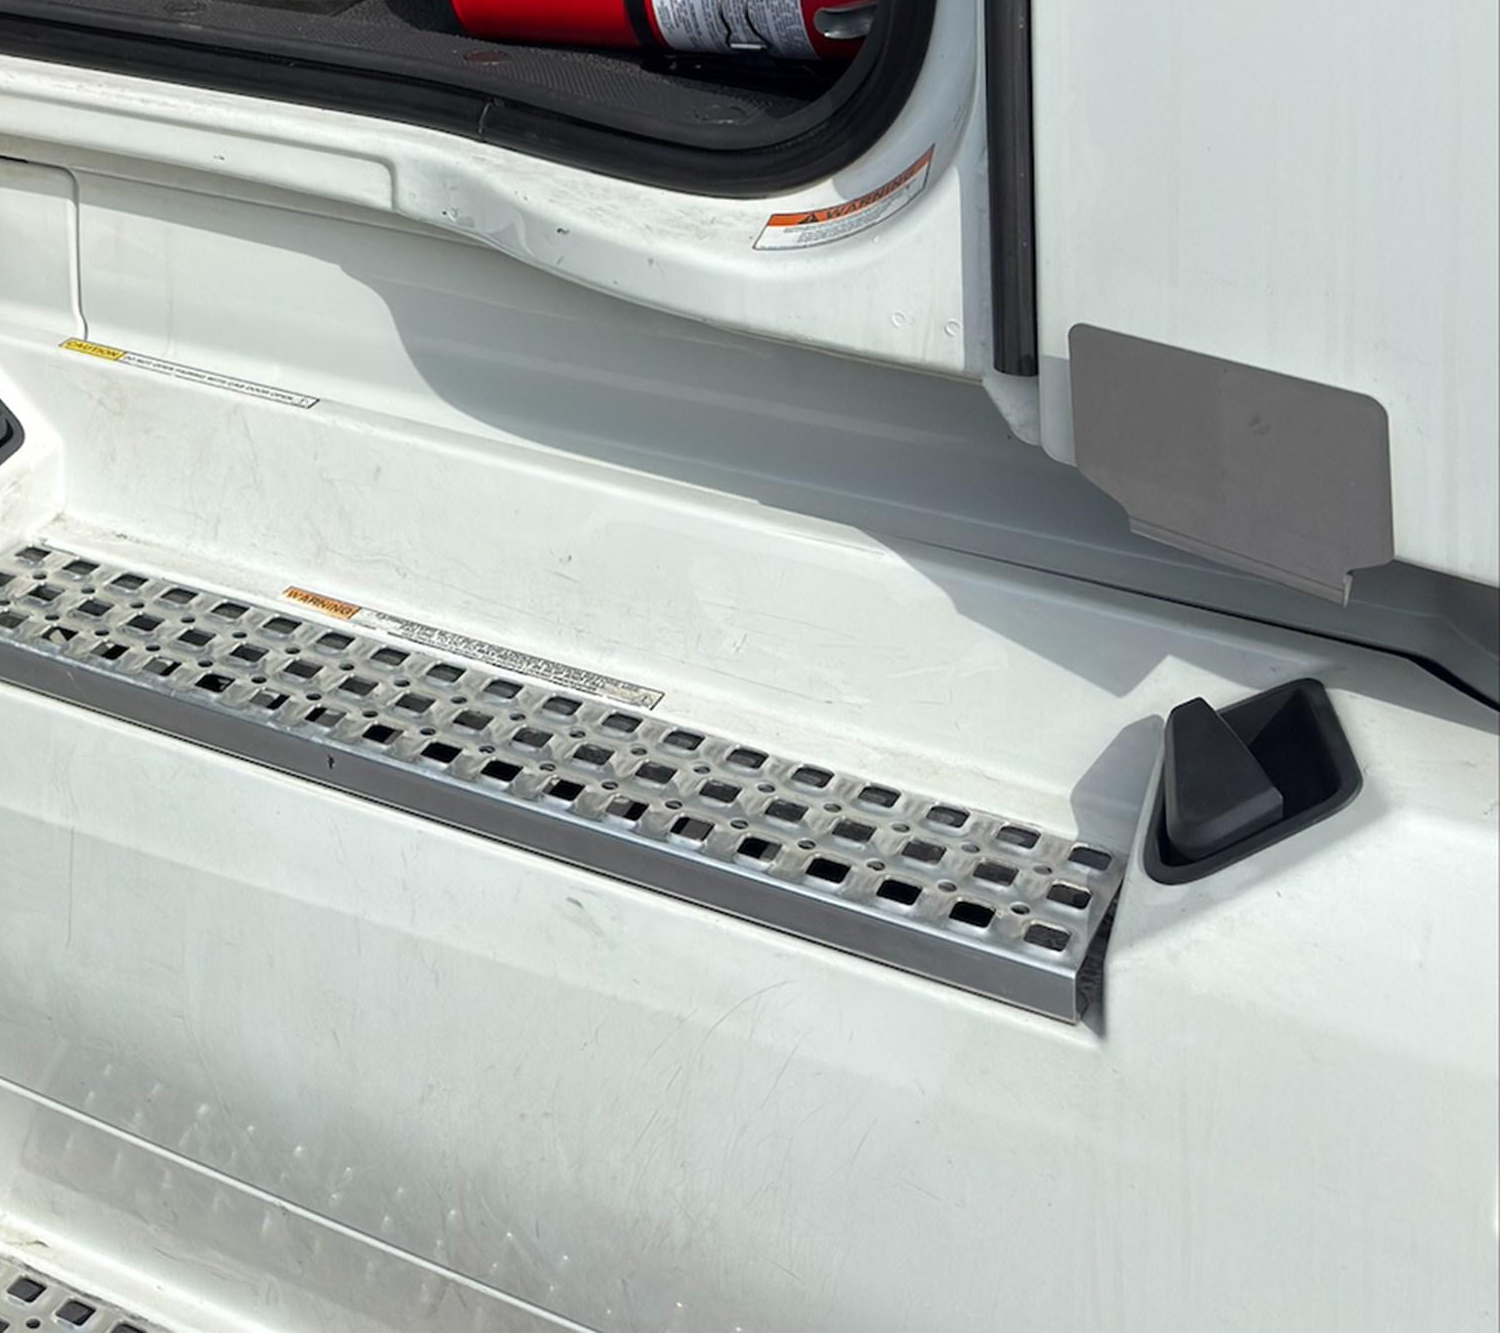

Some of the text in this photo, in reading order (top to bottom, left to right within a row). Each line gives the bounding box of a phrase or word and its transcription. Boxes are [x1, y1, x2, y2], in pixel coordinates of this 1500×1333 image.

[826, 172, 911, 220] WARNING
[66, 340, 119, 358] CAUTION
[287, 589, 354, 616] WARNING
